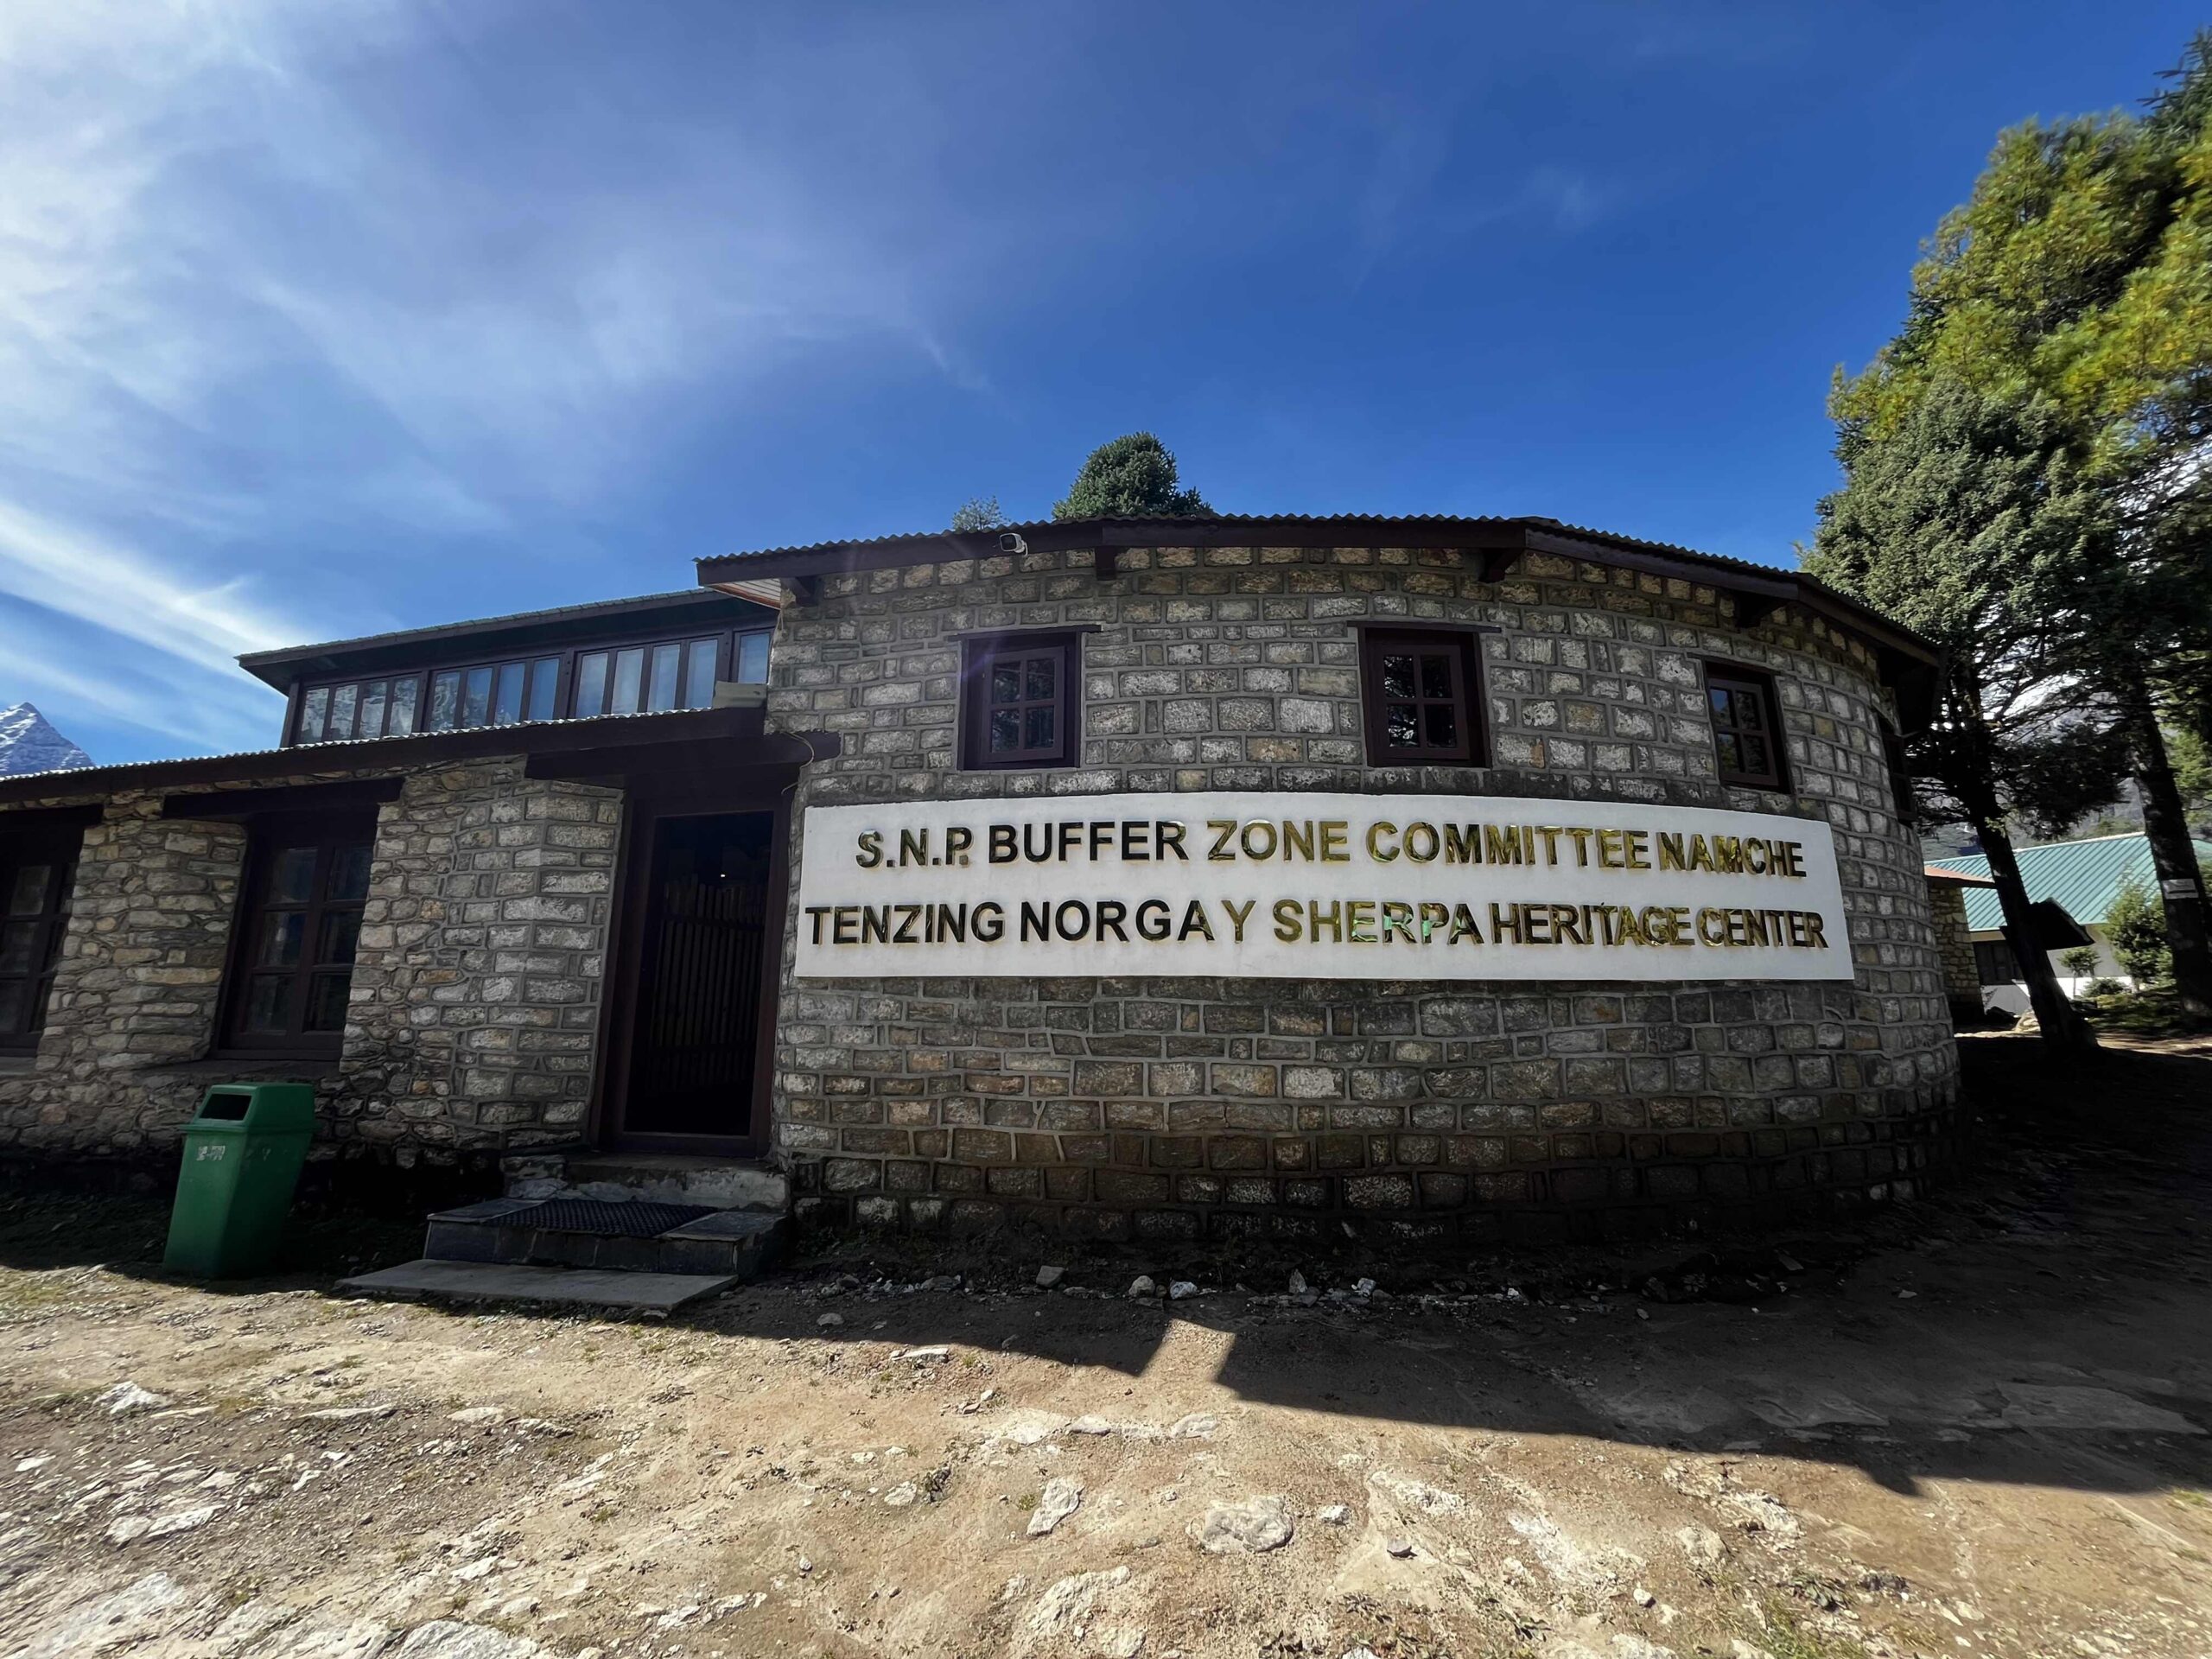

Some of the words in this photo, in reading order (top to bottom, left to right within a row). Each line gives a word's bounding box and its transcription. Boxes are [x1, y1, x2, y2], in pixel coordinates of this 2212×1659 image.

[988, 820, 1190, 864] BUFFER
[1206, 819, 1351, 862] ZONE
[1366, 821, 1651, 869] COMMITTEE
[1656, 831, 1807, 878] NAMCHE
[804, 901, 1005, 945] TENZING
[1020, 899, 1256, 944] NORGAY
[1273, 899, 1484, 945] SHERPA
[1488, 902, 1695, 947] HERITAGE
[1696, 906, 1829, 949] CENTER
